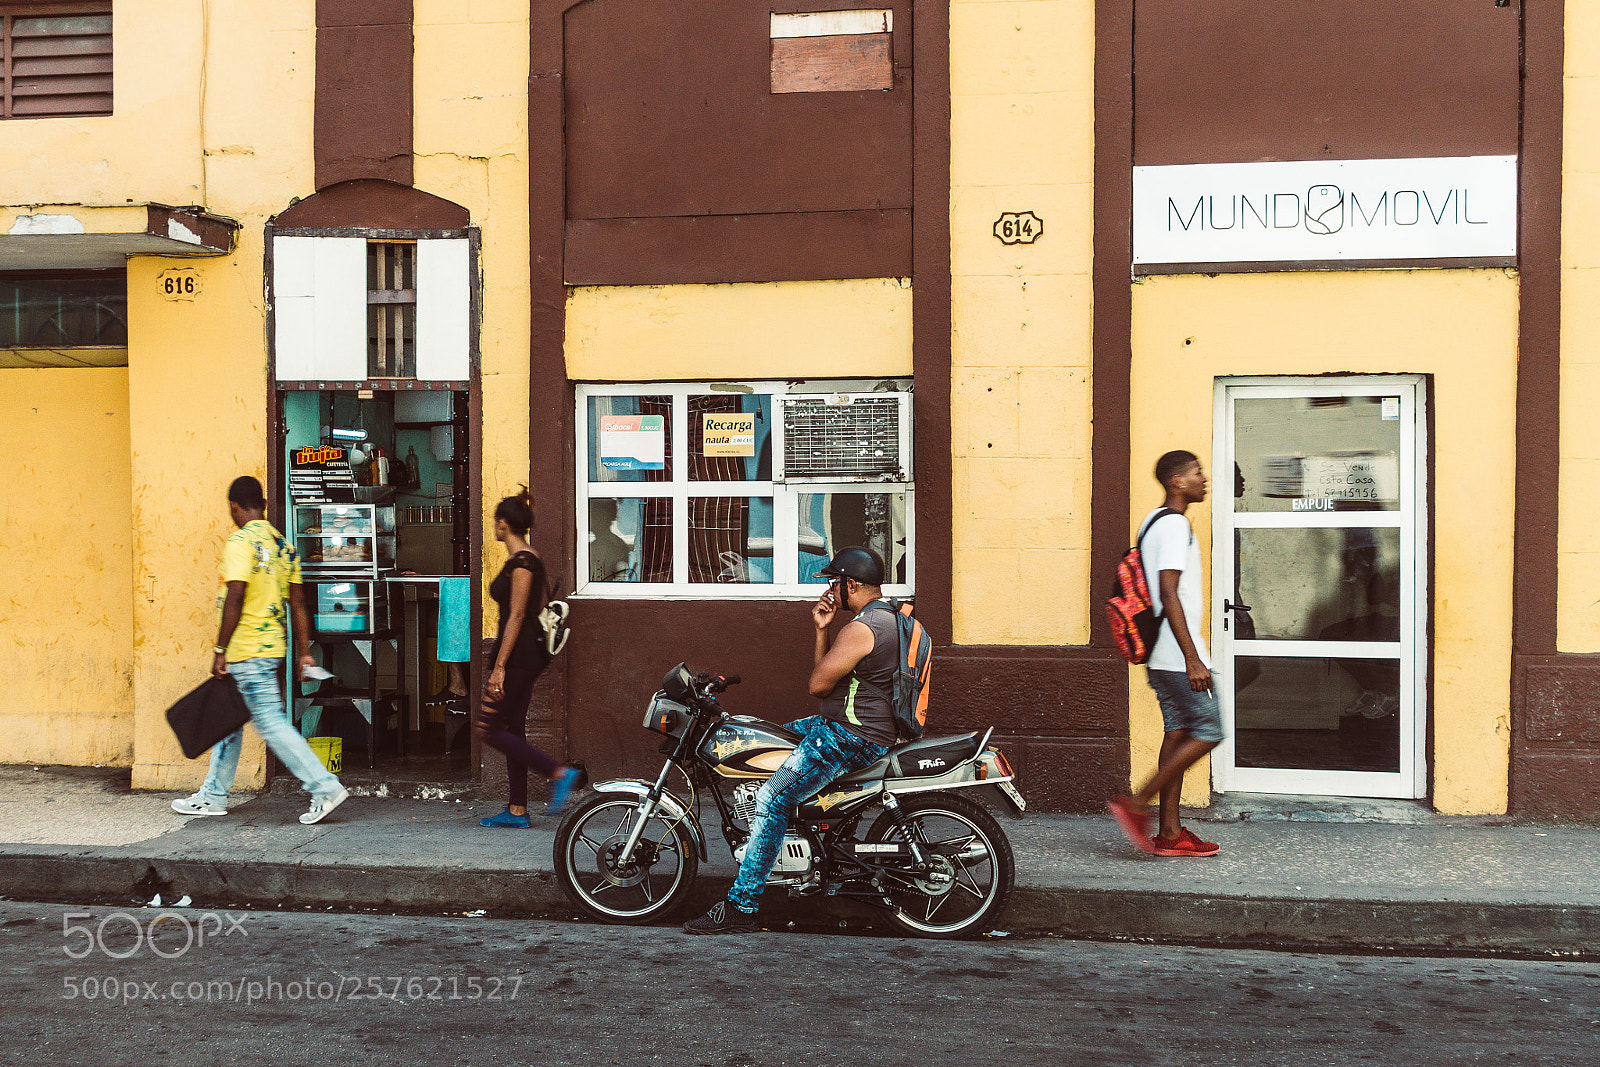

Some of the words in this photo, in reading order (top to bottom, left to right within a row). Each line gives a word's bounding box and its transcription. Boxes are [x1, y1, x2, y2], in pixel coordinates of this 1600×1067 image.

[1351, 189, 1488, 227] MOVIL
[1003, 219, 1032, 238] 614
[165, 276, 194, 294] 616
[705, 419, 752, 433] Recarga
[705, 435, 730, 444] nauta
[1346, 473, 1376, 485] Casa
[1292, 498, 1334, 511] EMPUJE
